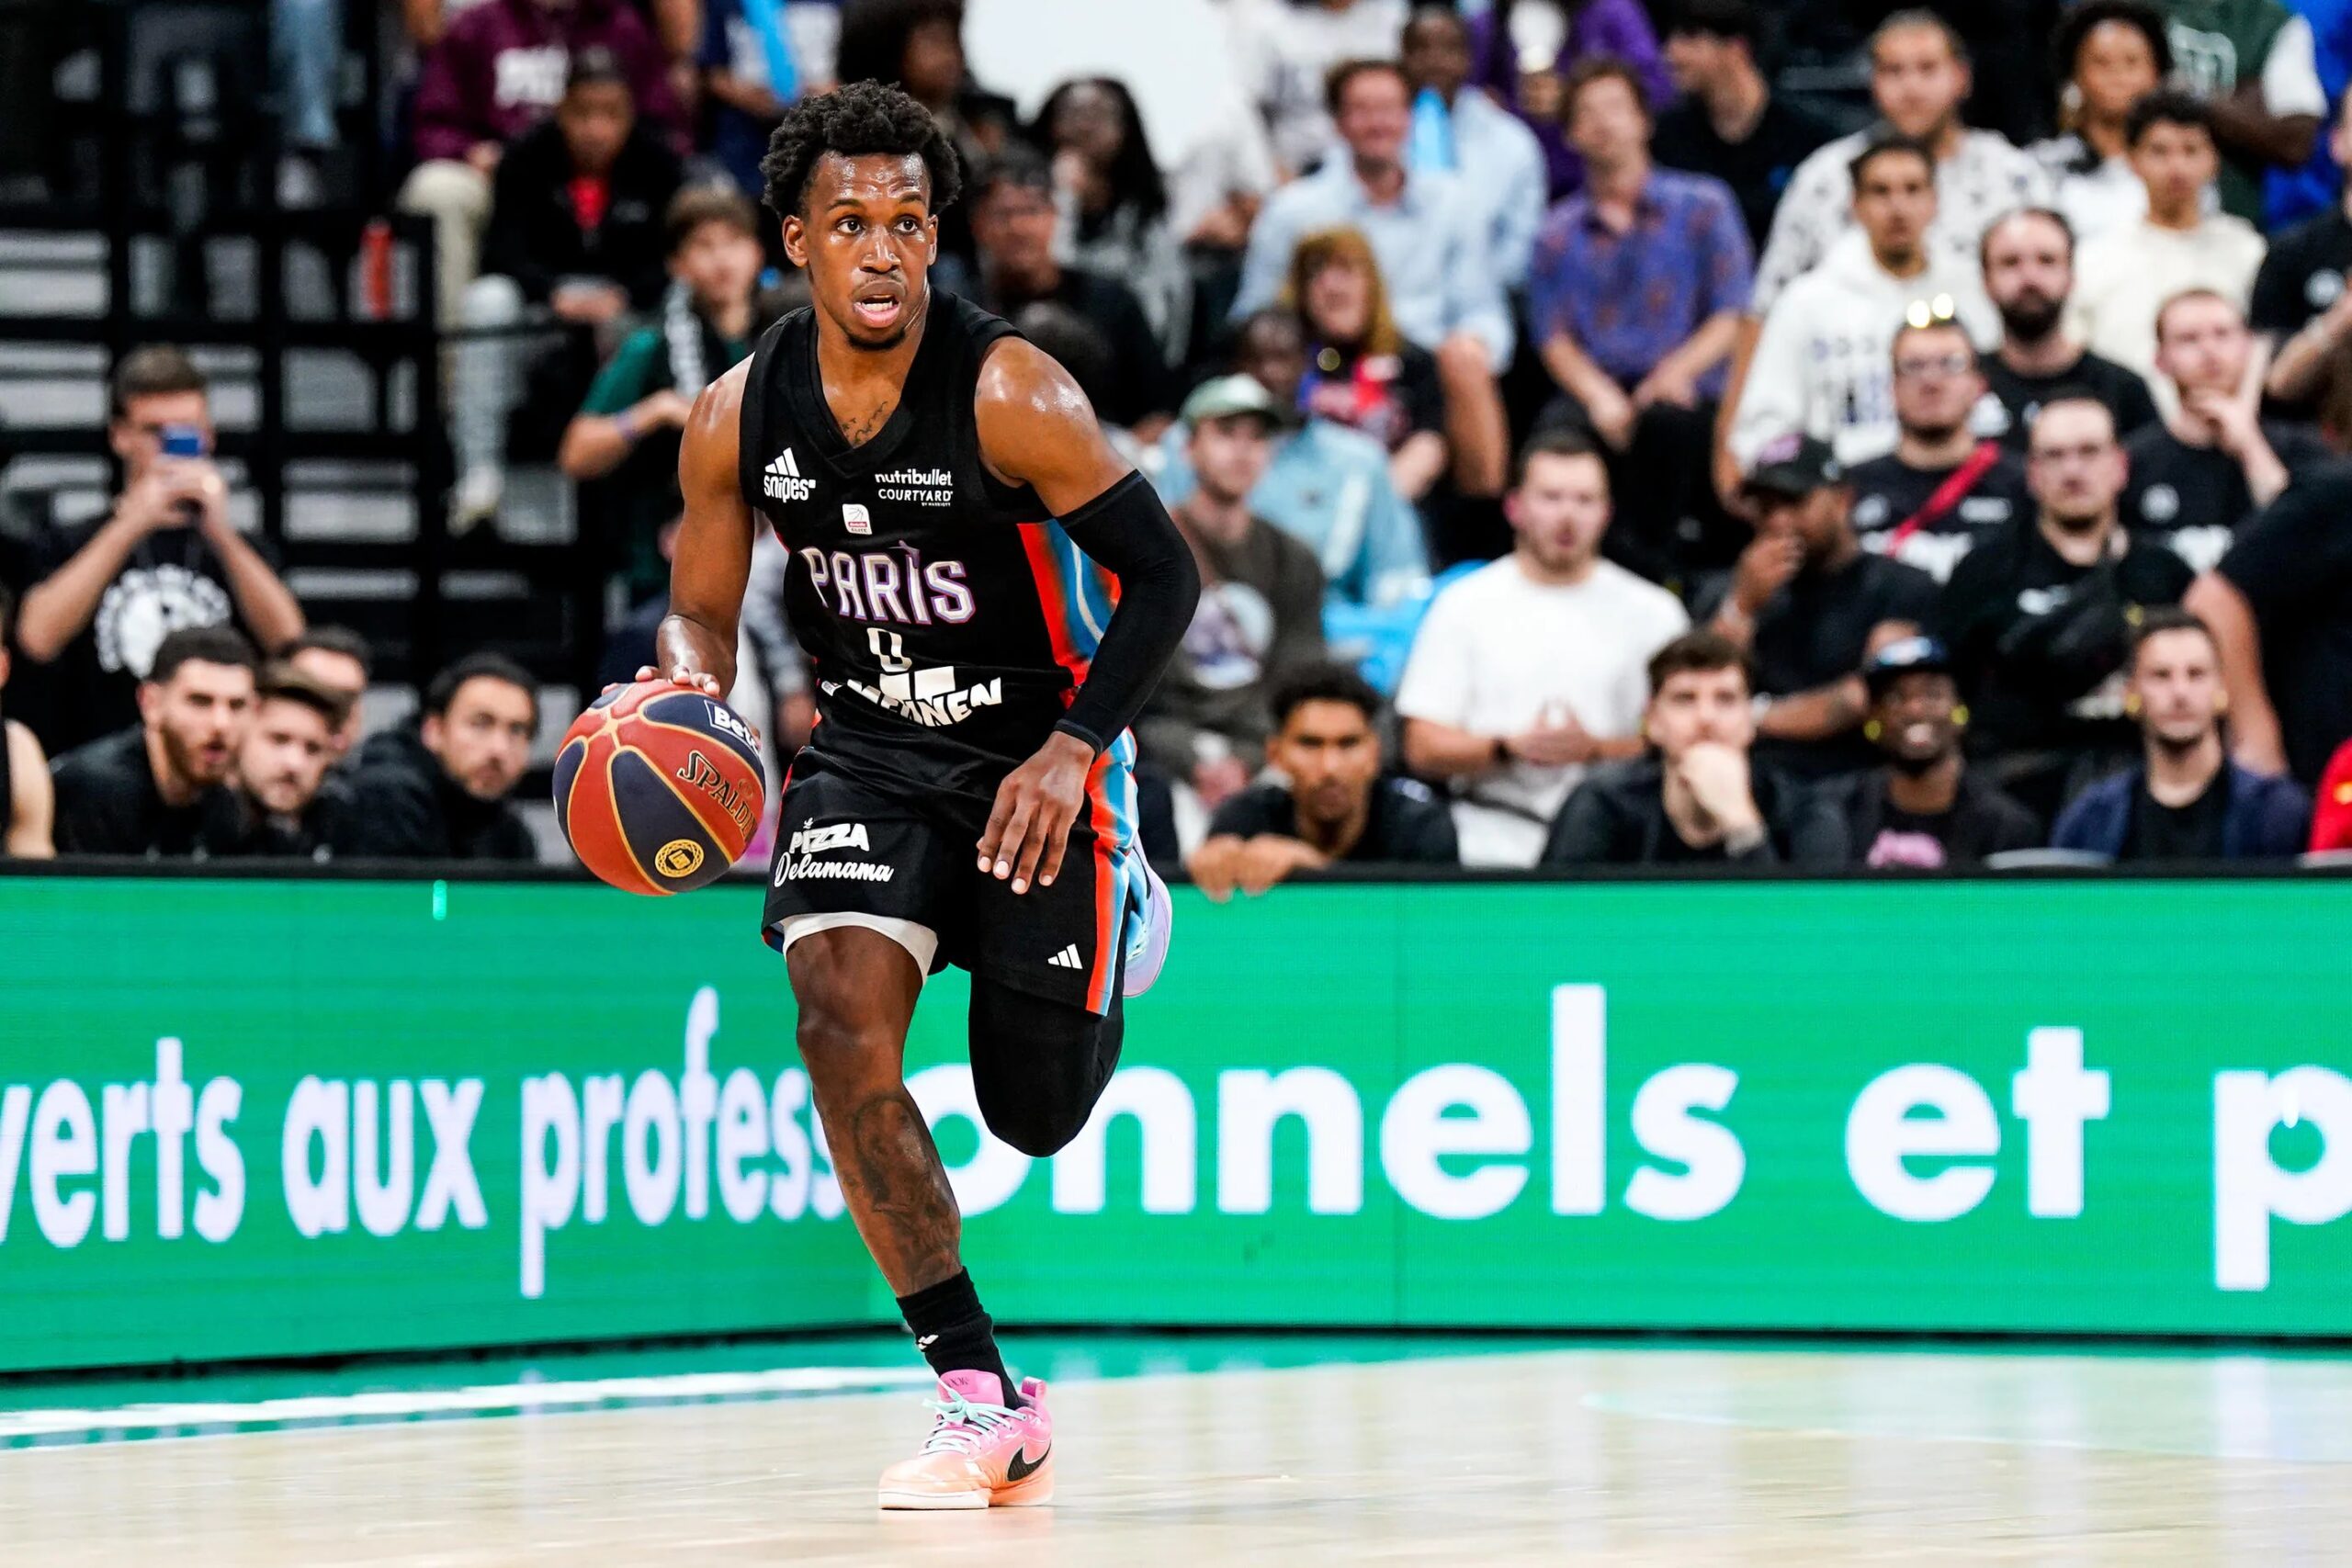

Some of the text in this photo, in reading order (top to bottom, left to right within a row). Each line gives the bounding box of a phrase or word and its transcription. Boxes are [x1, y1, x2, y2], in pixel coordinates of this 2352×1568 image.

[763, 475, 809, 503] snipes
[878, 489, 953, 502] COURTYARD
[797, 546, 977, 626] PARIS
[788, 823, 870, 854] PIZZA
[774, 852, 895, 888] Delamama
[282, 1075, 488, 1236] aux
[1845, 1026, 2110, 1222] et
